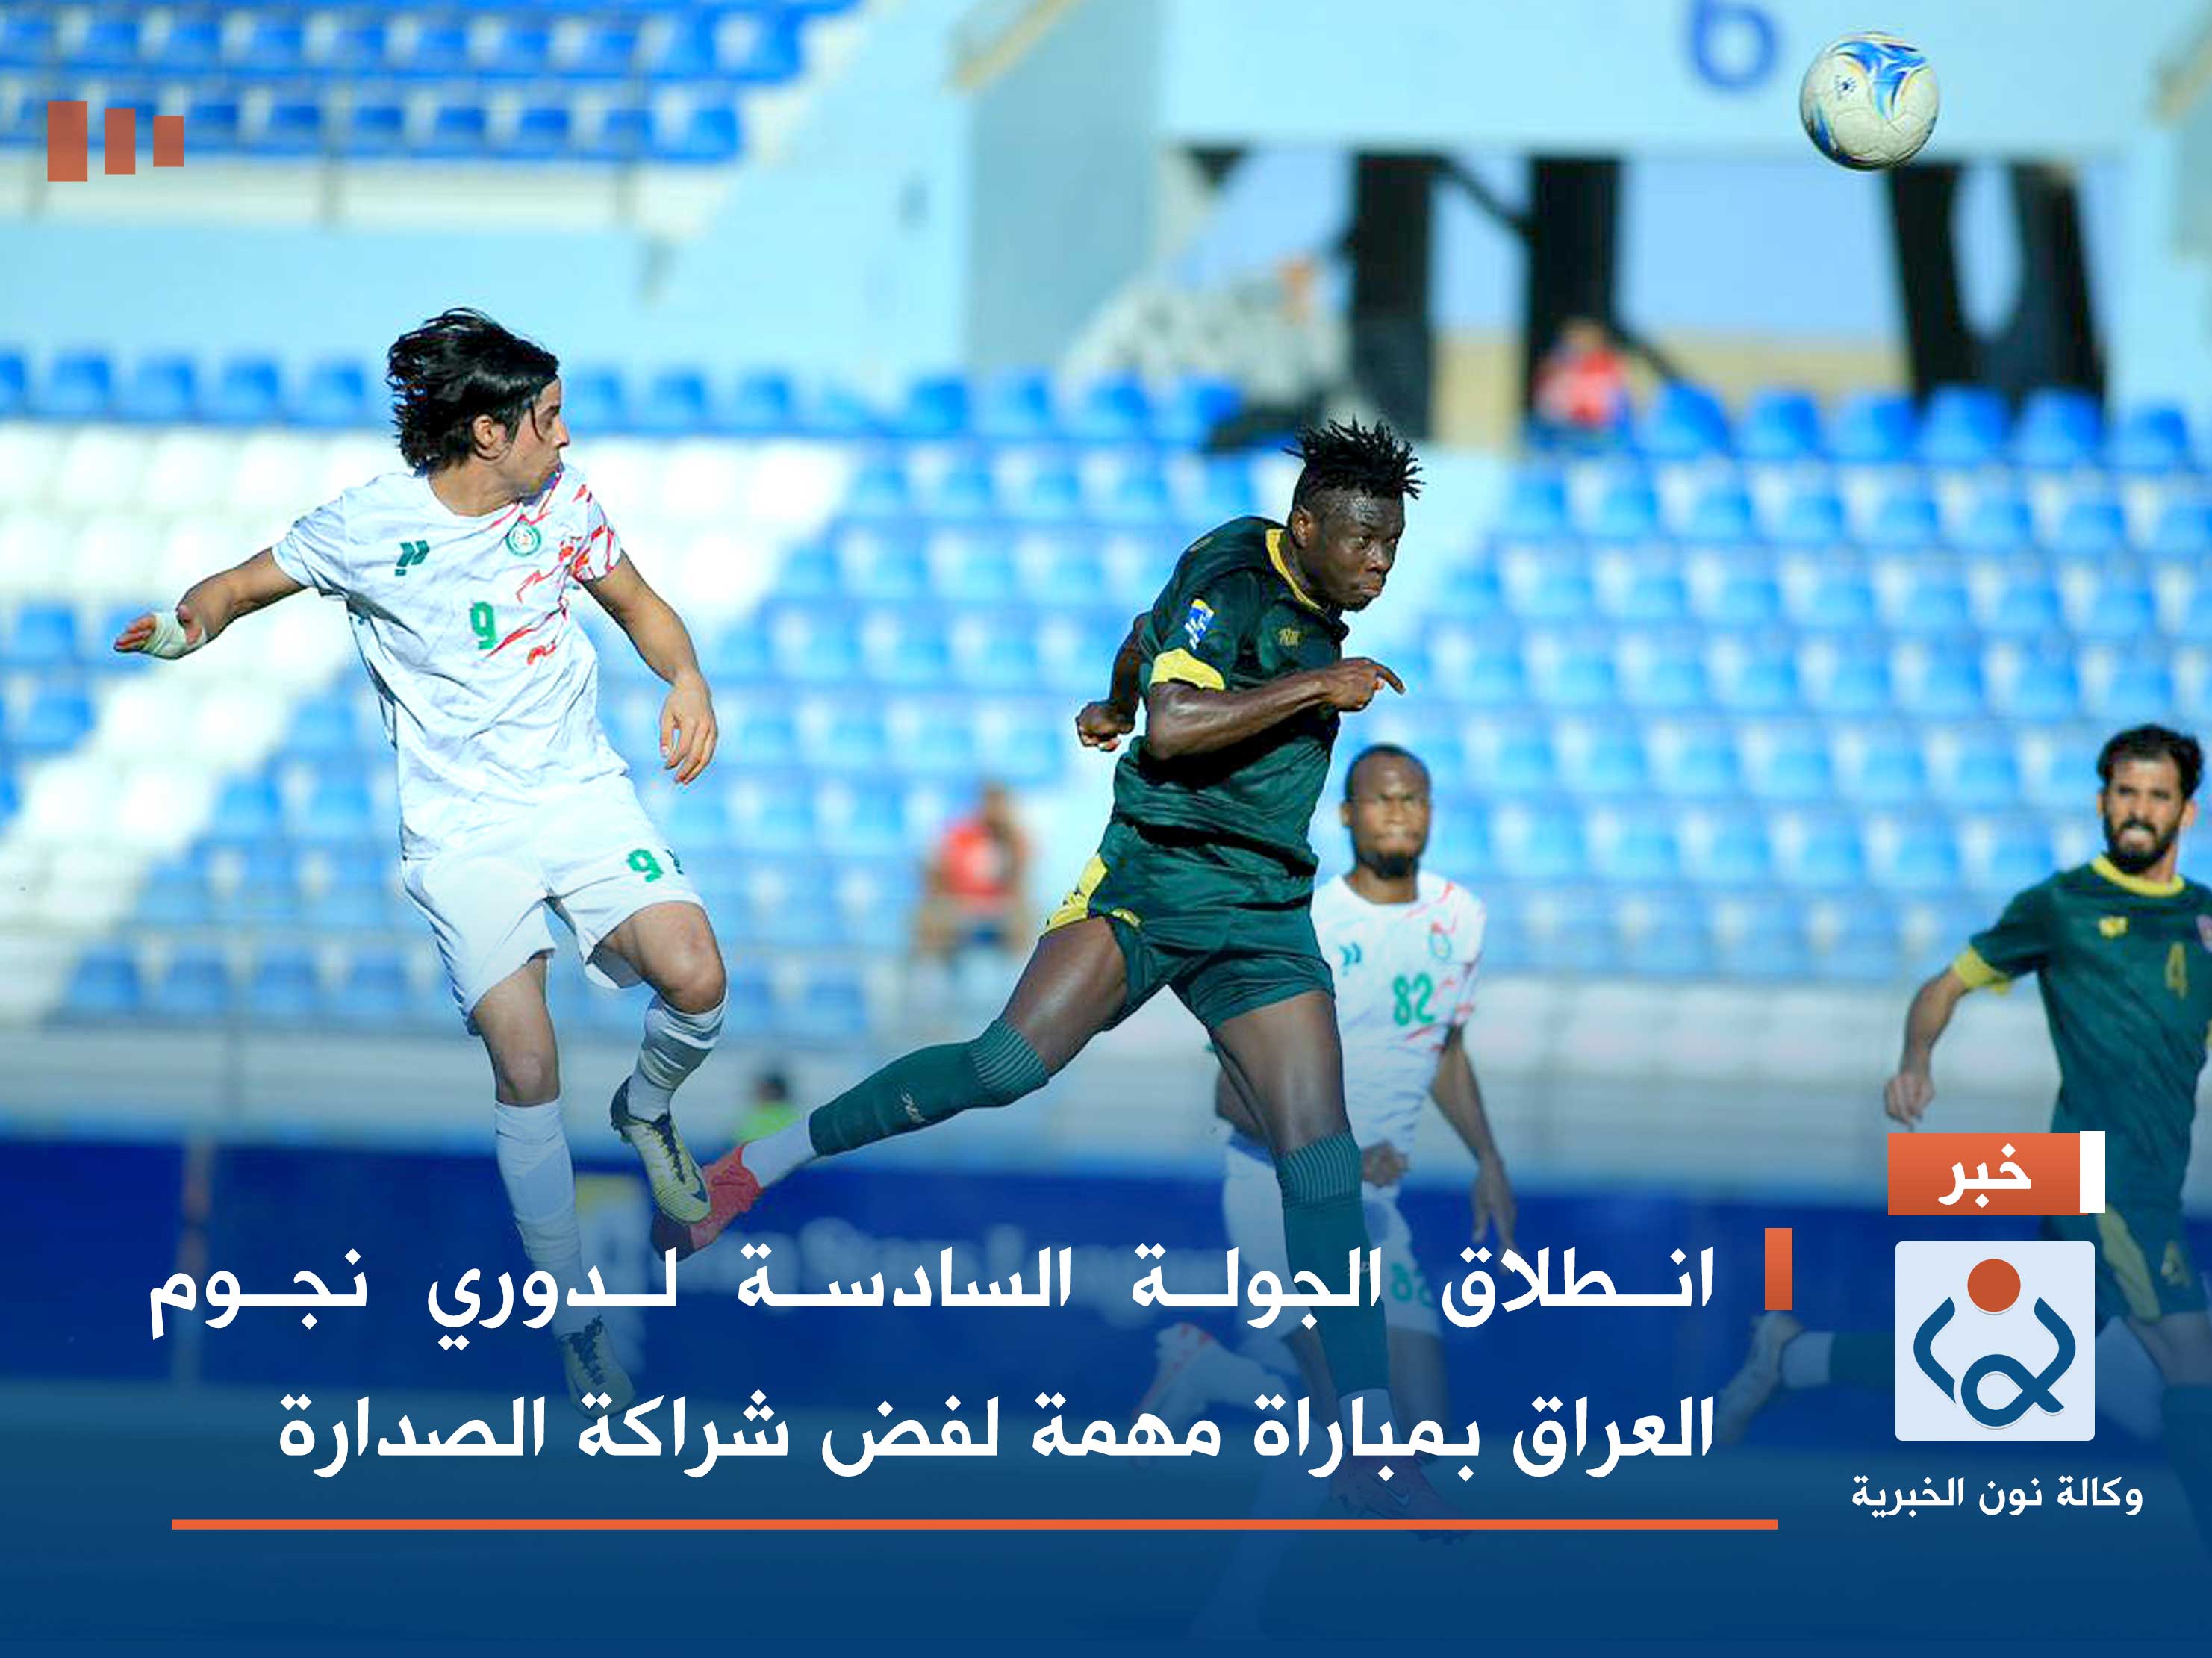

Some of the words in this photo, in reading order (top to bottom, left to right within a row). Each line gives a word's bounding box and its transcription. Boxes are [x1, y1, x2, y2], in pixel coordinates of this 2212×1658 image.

[470, 601, 497, 650] 9
[626, 848, 665, 883] 9
[1392, 973, 1435, 1026] 82
